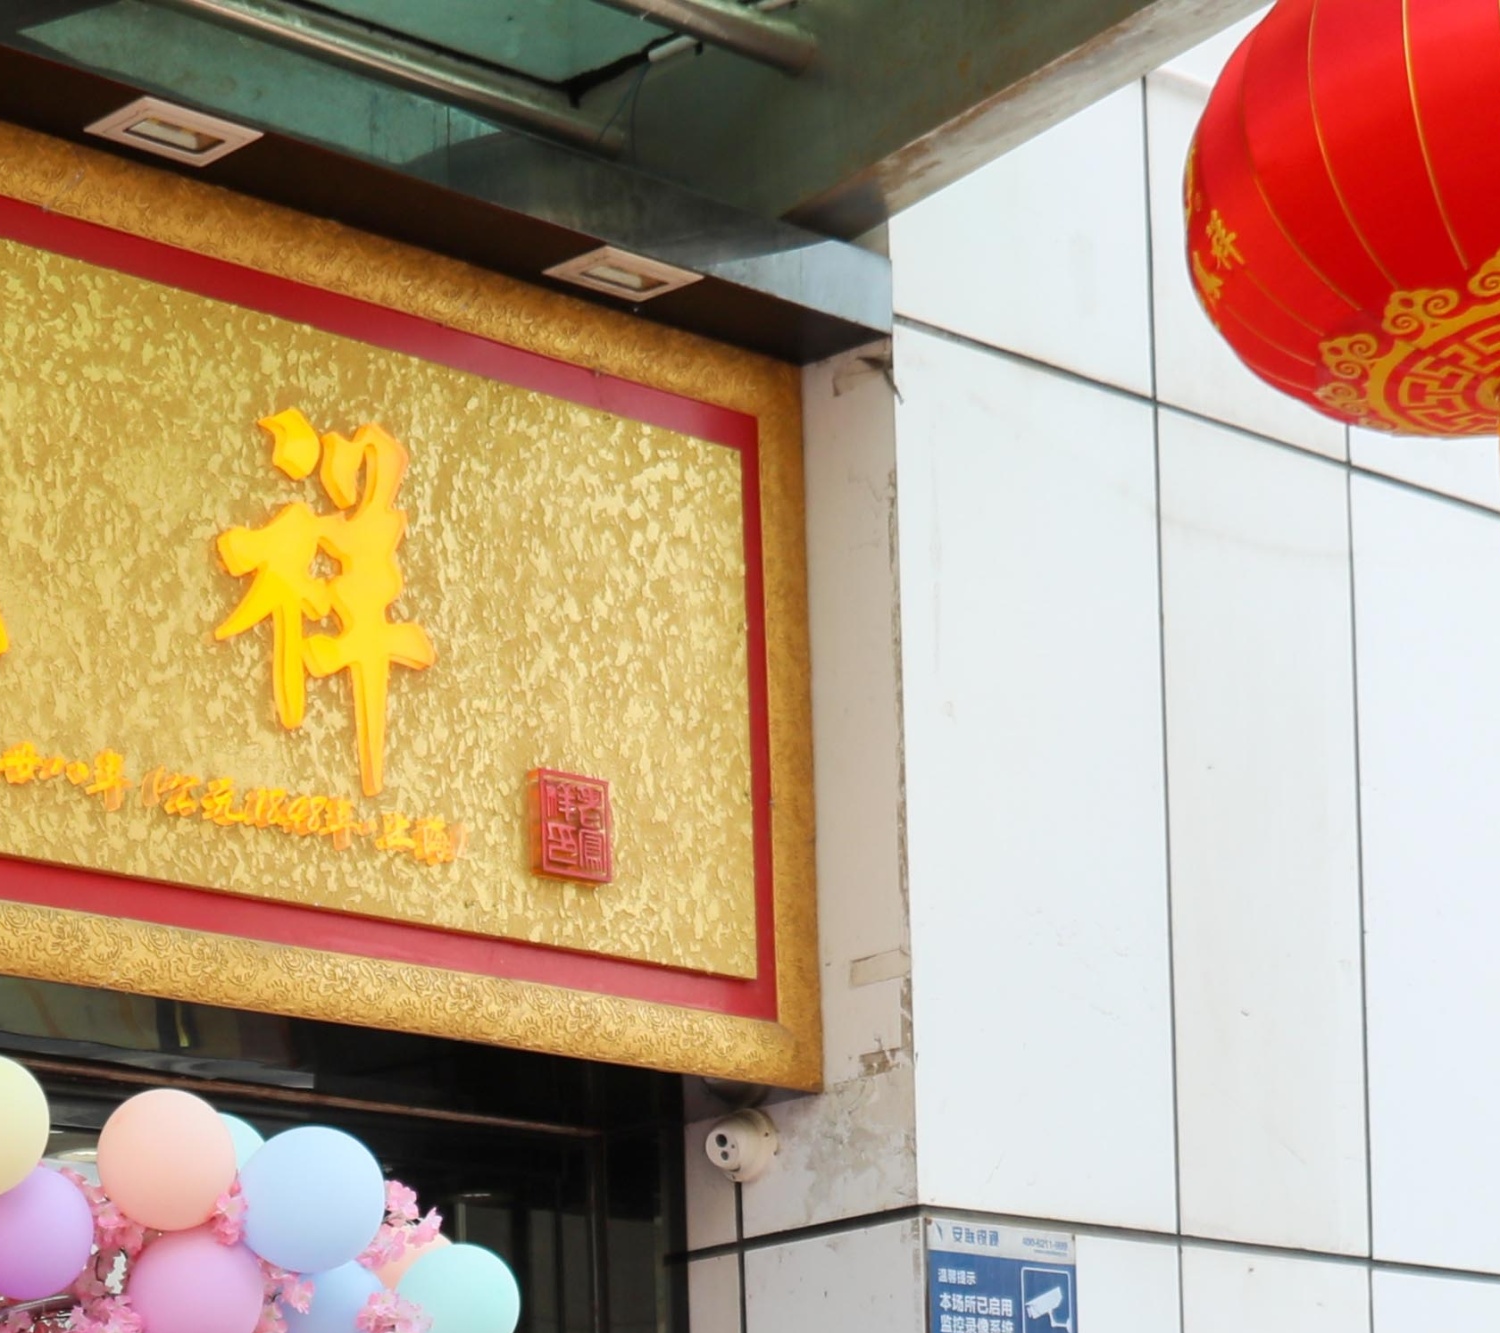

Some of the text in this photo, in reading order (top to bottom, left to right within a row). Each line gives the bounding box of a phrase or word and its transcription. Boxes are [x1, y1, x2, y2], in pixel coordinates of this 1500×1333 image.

[939, 1292, 1014, 1318] 本场所已启用
